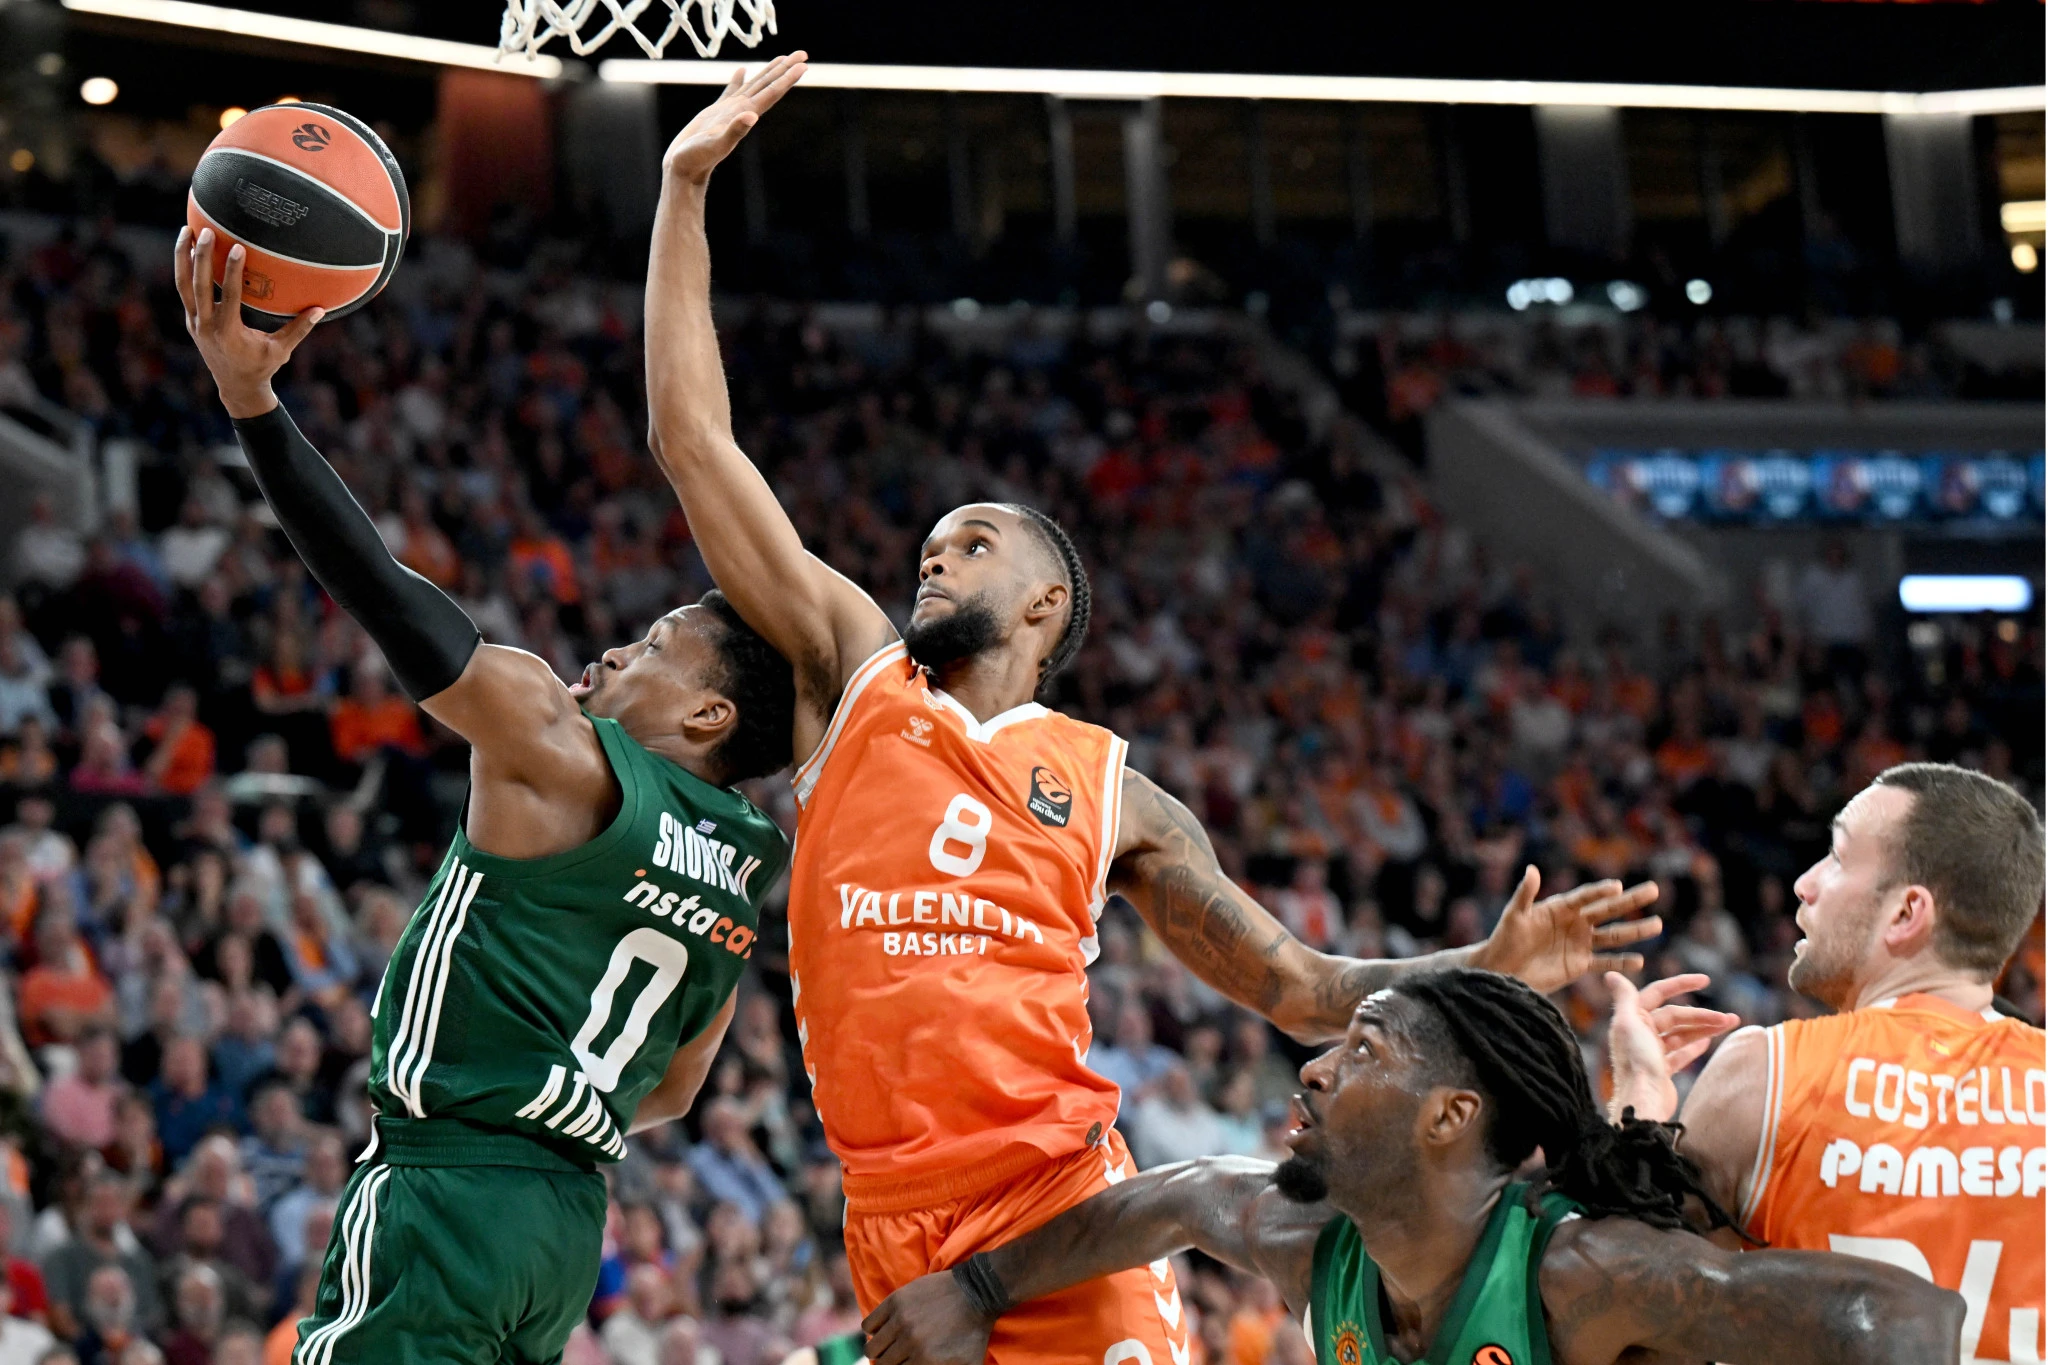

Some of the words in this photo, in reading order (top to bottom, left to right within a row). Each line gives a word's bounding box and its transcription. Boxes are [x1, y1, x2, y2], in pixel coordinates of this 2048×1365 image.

[234, 177, 309, 219] LEGACY
[900, 729, 932, 748] hummel
[929, 793, 992, 878] 8
[1029, 801, 1045, 815] abu
[1044, 809, 1067, 826] dhabi
[652, 811, 739, 896] SHORTS
[840, 883, 1044, 945] VALENCIA
[883, 931, 993, 956] BASKET
[569, 927, 688, 1093] 0
[1845, 1057, 2046, 1130] COSTELLO
